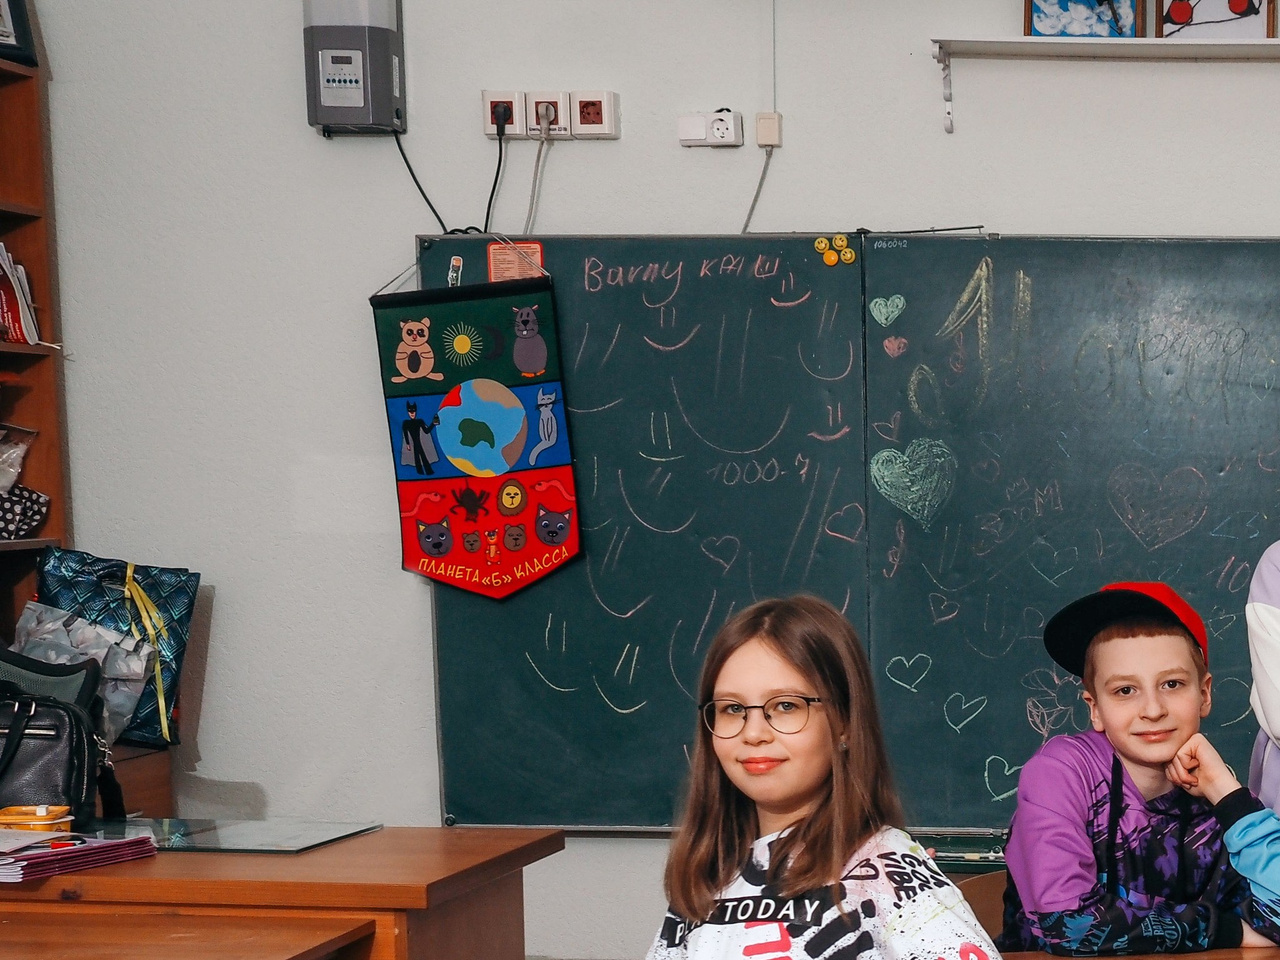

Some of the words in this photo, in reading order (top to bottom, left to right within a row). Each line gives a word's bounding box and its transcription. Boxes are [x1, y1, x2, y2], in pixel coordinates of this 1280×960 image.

[418, 558, 479, 583] ПЛАНЕТА
[513, 546, 569, 579] КЛАССА
[724, 899, 820, 923] TODAY
